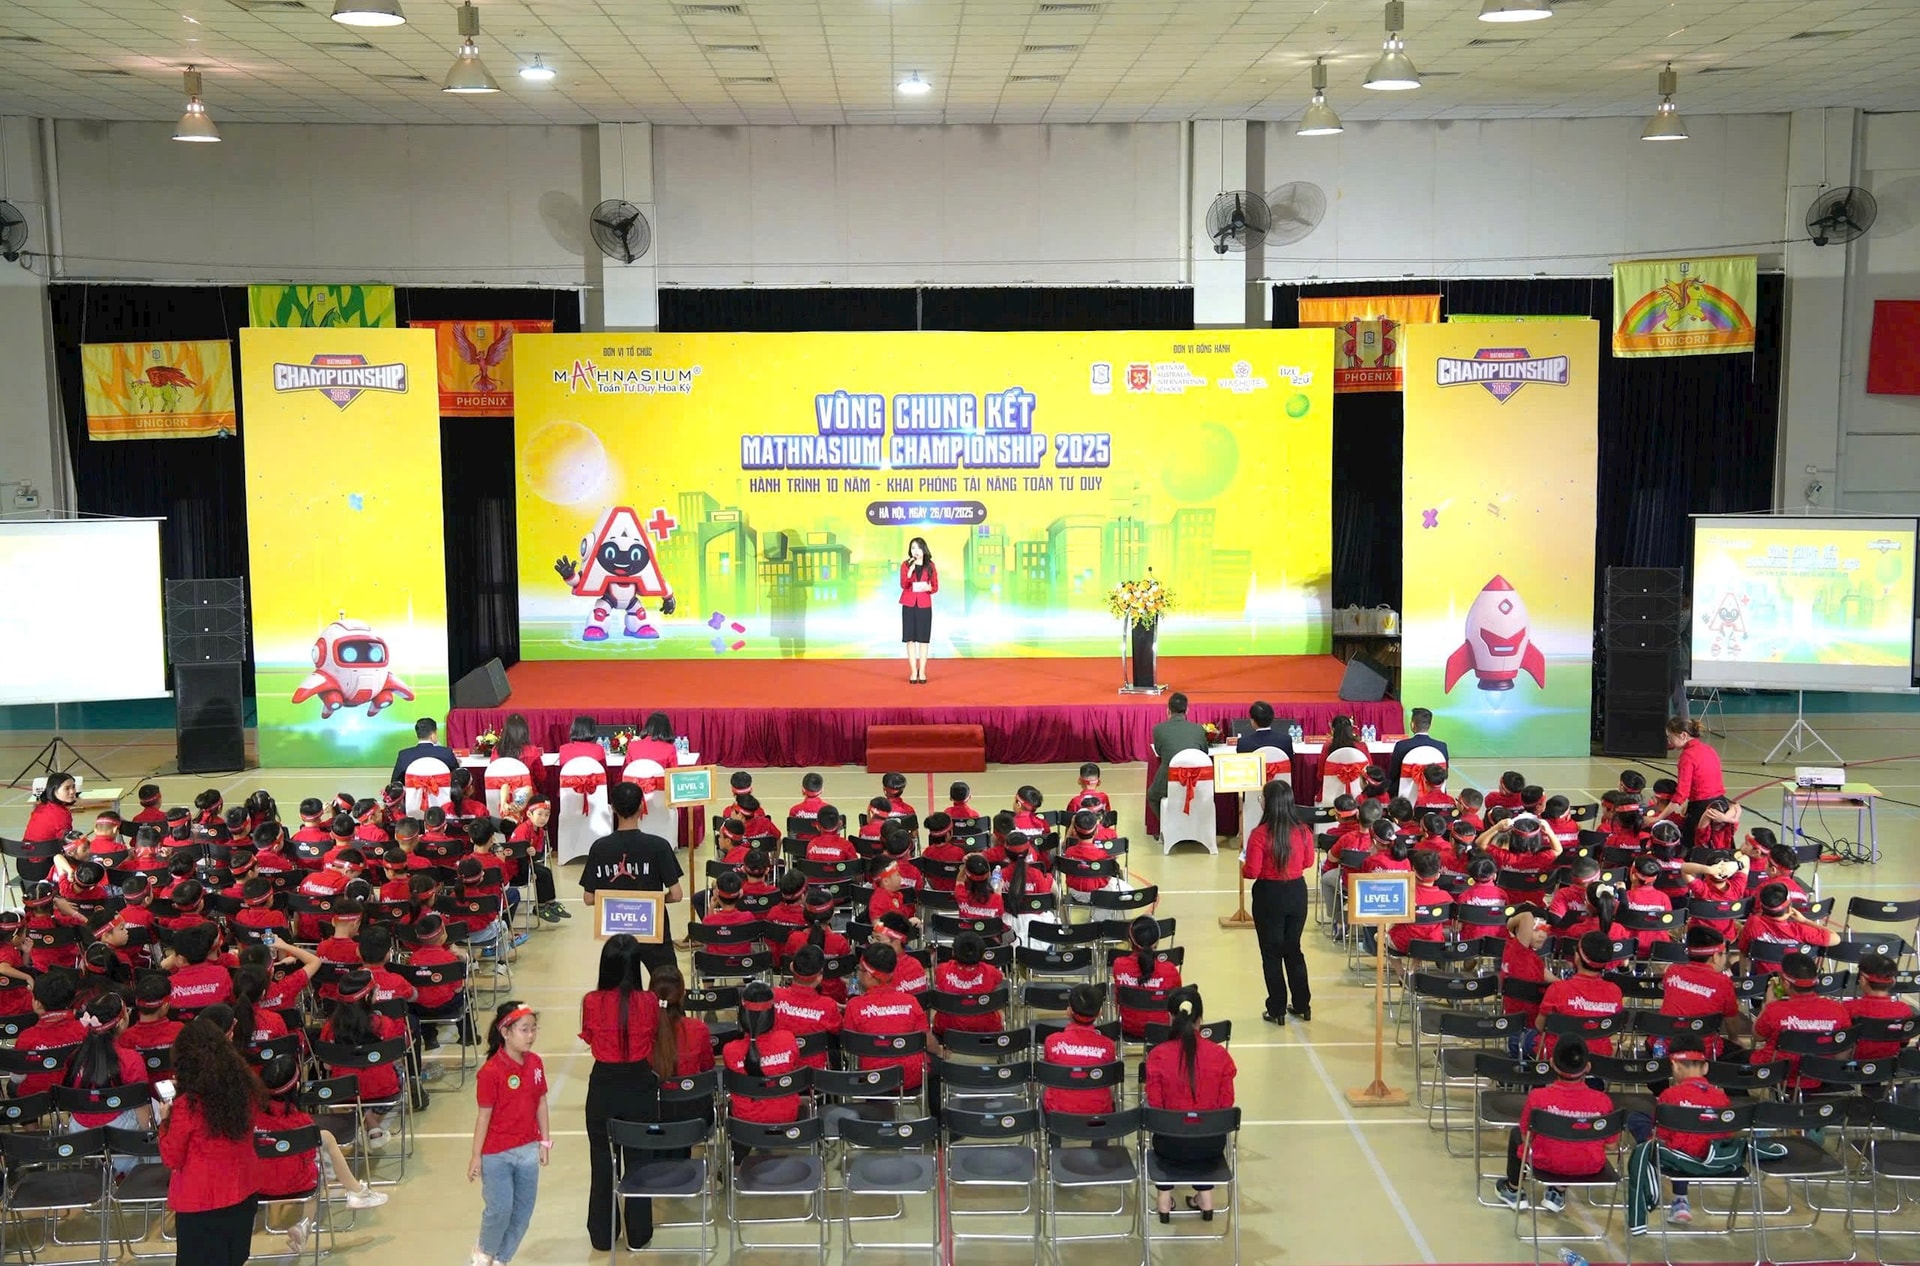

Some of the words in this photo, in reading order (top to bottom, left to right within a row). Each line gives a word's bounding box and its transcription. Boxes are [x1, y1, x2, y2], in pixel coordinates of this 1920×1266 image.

[1657, 335, 1709, 346] UNICORN
[1439, 356, 1566, 384] CHAMPIONSHIP
[274, 364, 404, 390] CHAMPIONSHIP
[1344, 372, 1393, 382] PHOENIX
[598, 383, 620, 392] Toán
[623, 383, 635, 392] Tư
[637, 383, 655, 394] Duy
[658, 384, 676, 392] Hoa
[456, 396, 507, 406] PHOENIX
[816, 391, 884, 434] VÒNG
[894, 394, 975, 433] CHUNG
[986, 388, 1034, 432] KẾT
[135, 417, 189, 428] UNICORN
[743, 436, 881, 467] MATHNASIUM
[891, 435, 1045, 467] CHAMPIONSHIP
[1056, 434, 1110, 466] 2025
[750, 476, 781, 492] HÀNH
[786, 476, 820, 492] TRÌNH
[826, 478, 838, 492] 10
[844, 476, 870, 492] NĂM
[887, 478, 913, 492] KHAI
[919, 475, 957, 492] PHÓNG
[963, 475, 981, 492] TÀI
[986, 475, 1017, 491] NĂNG
[1023, 475, 1054, 491] TOÁN
[1059, 475, 1075, 491] TƯ
[1080, 476, 1102, 491] DUY
[878, 506, 890, 519] HÀ
[929, 506, 974, 520] 26/10/2025
[677, 782, 697, 791] LEVEL
[1364, 894, 1390, 903] LEVEL
[1392, 894, 1399, 903] 5
[610, 912, 638, 922] LEVEL
[639, 913, 647, 922] 6
